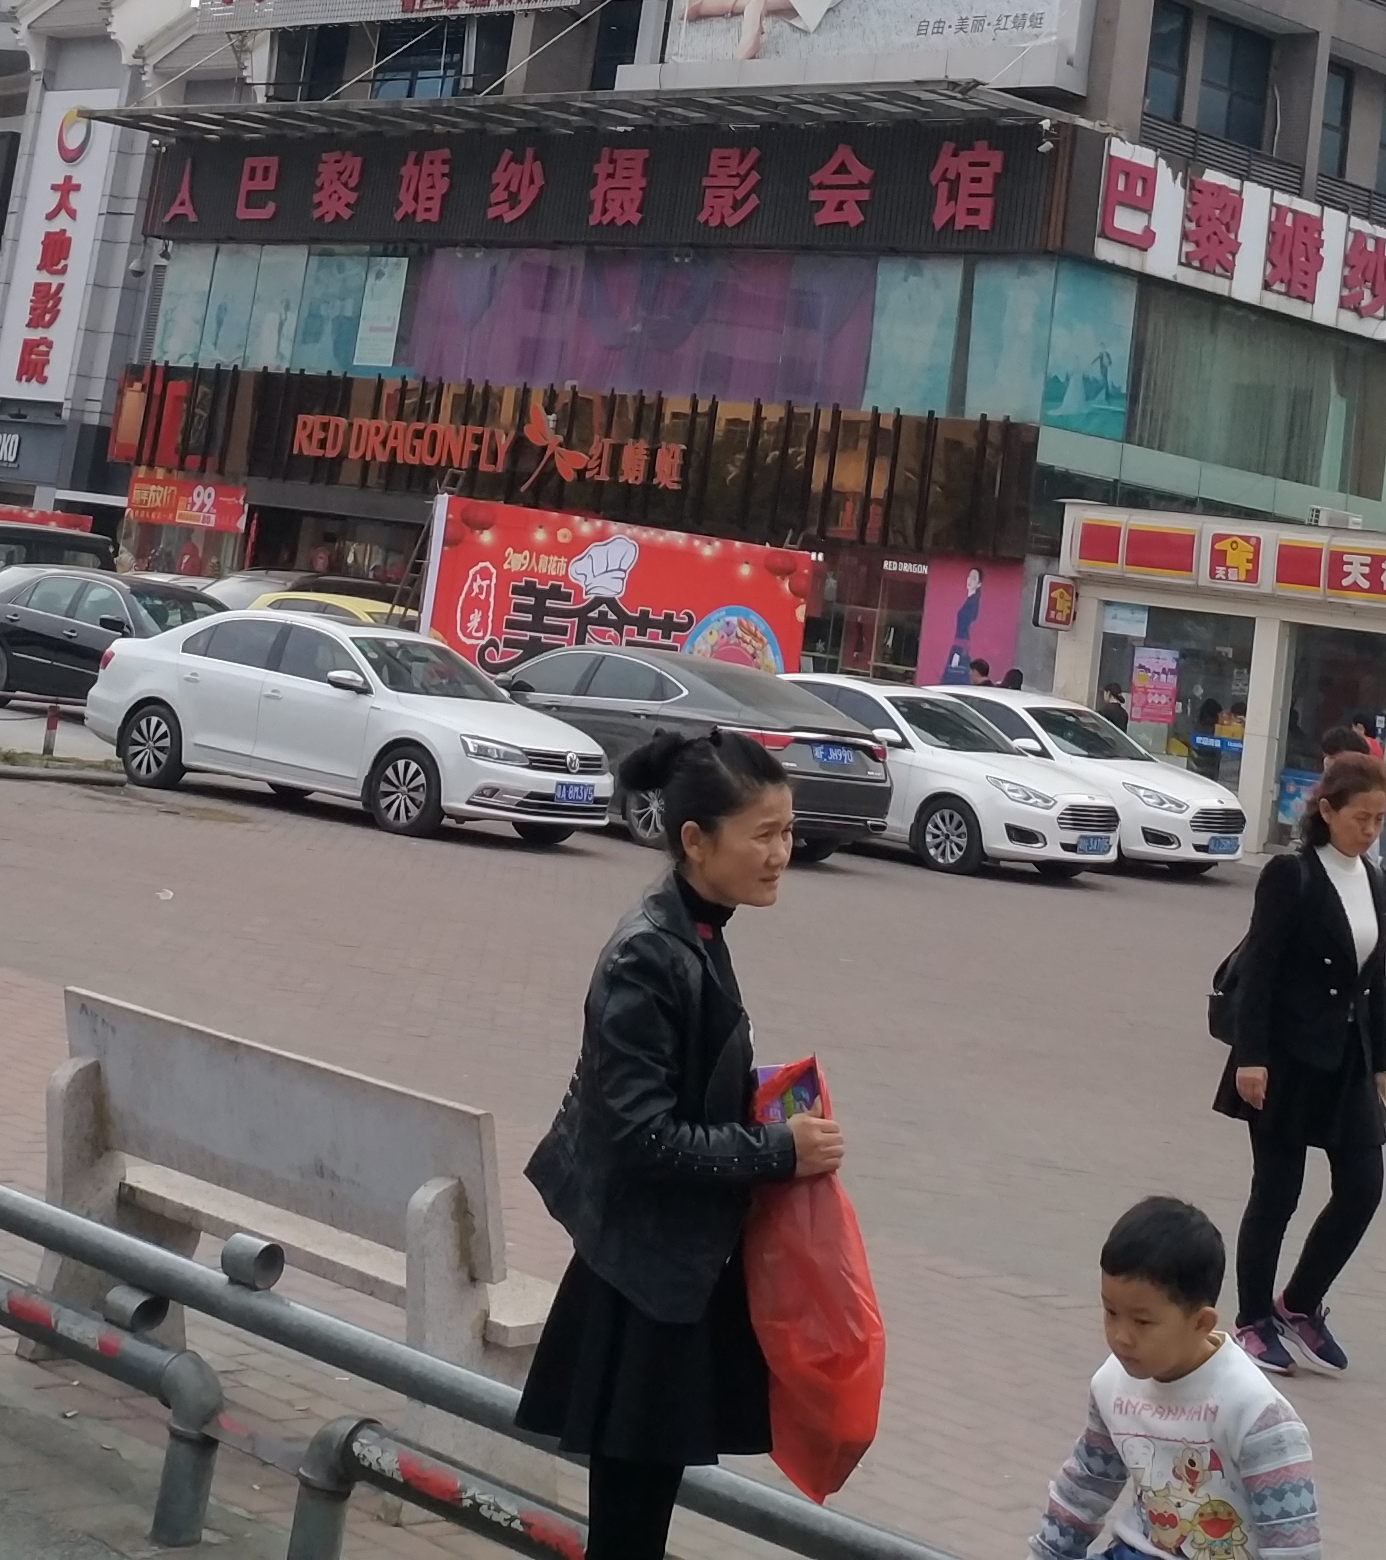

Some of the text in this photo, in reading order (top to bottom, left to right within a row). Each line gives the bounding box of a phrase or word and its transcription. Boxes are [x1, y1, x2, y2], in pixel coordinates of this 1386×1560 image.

[234, 140, 1005, 232] 巴黎婚纱摄影会馆
[15, 174, 82, 385] 大地影院
[293, 414, 513, 473] RED DRAGONFLY
[585, 435, 688, 490] 红蜻蜓
